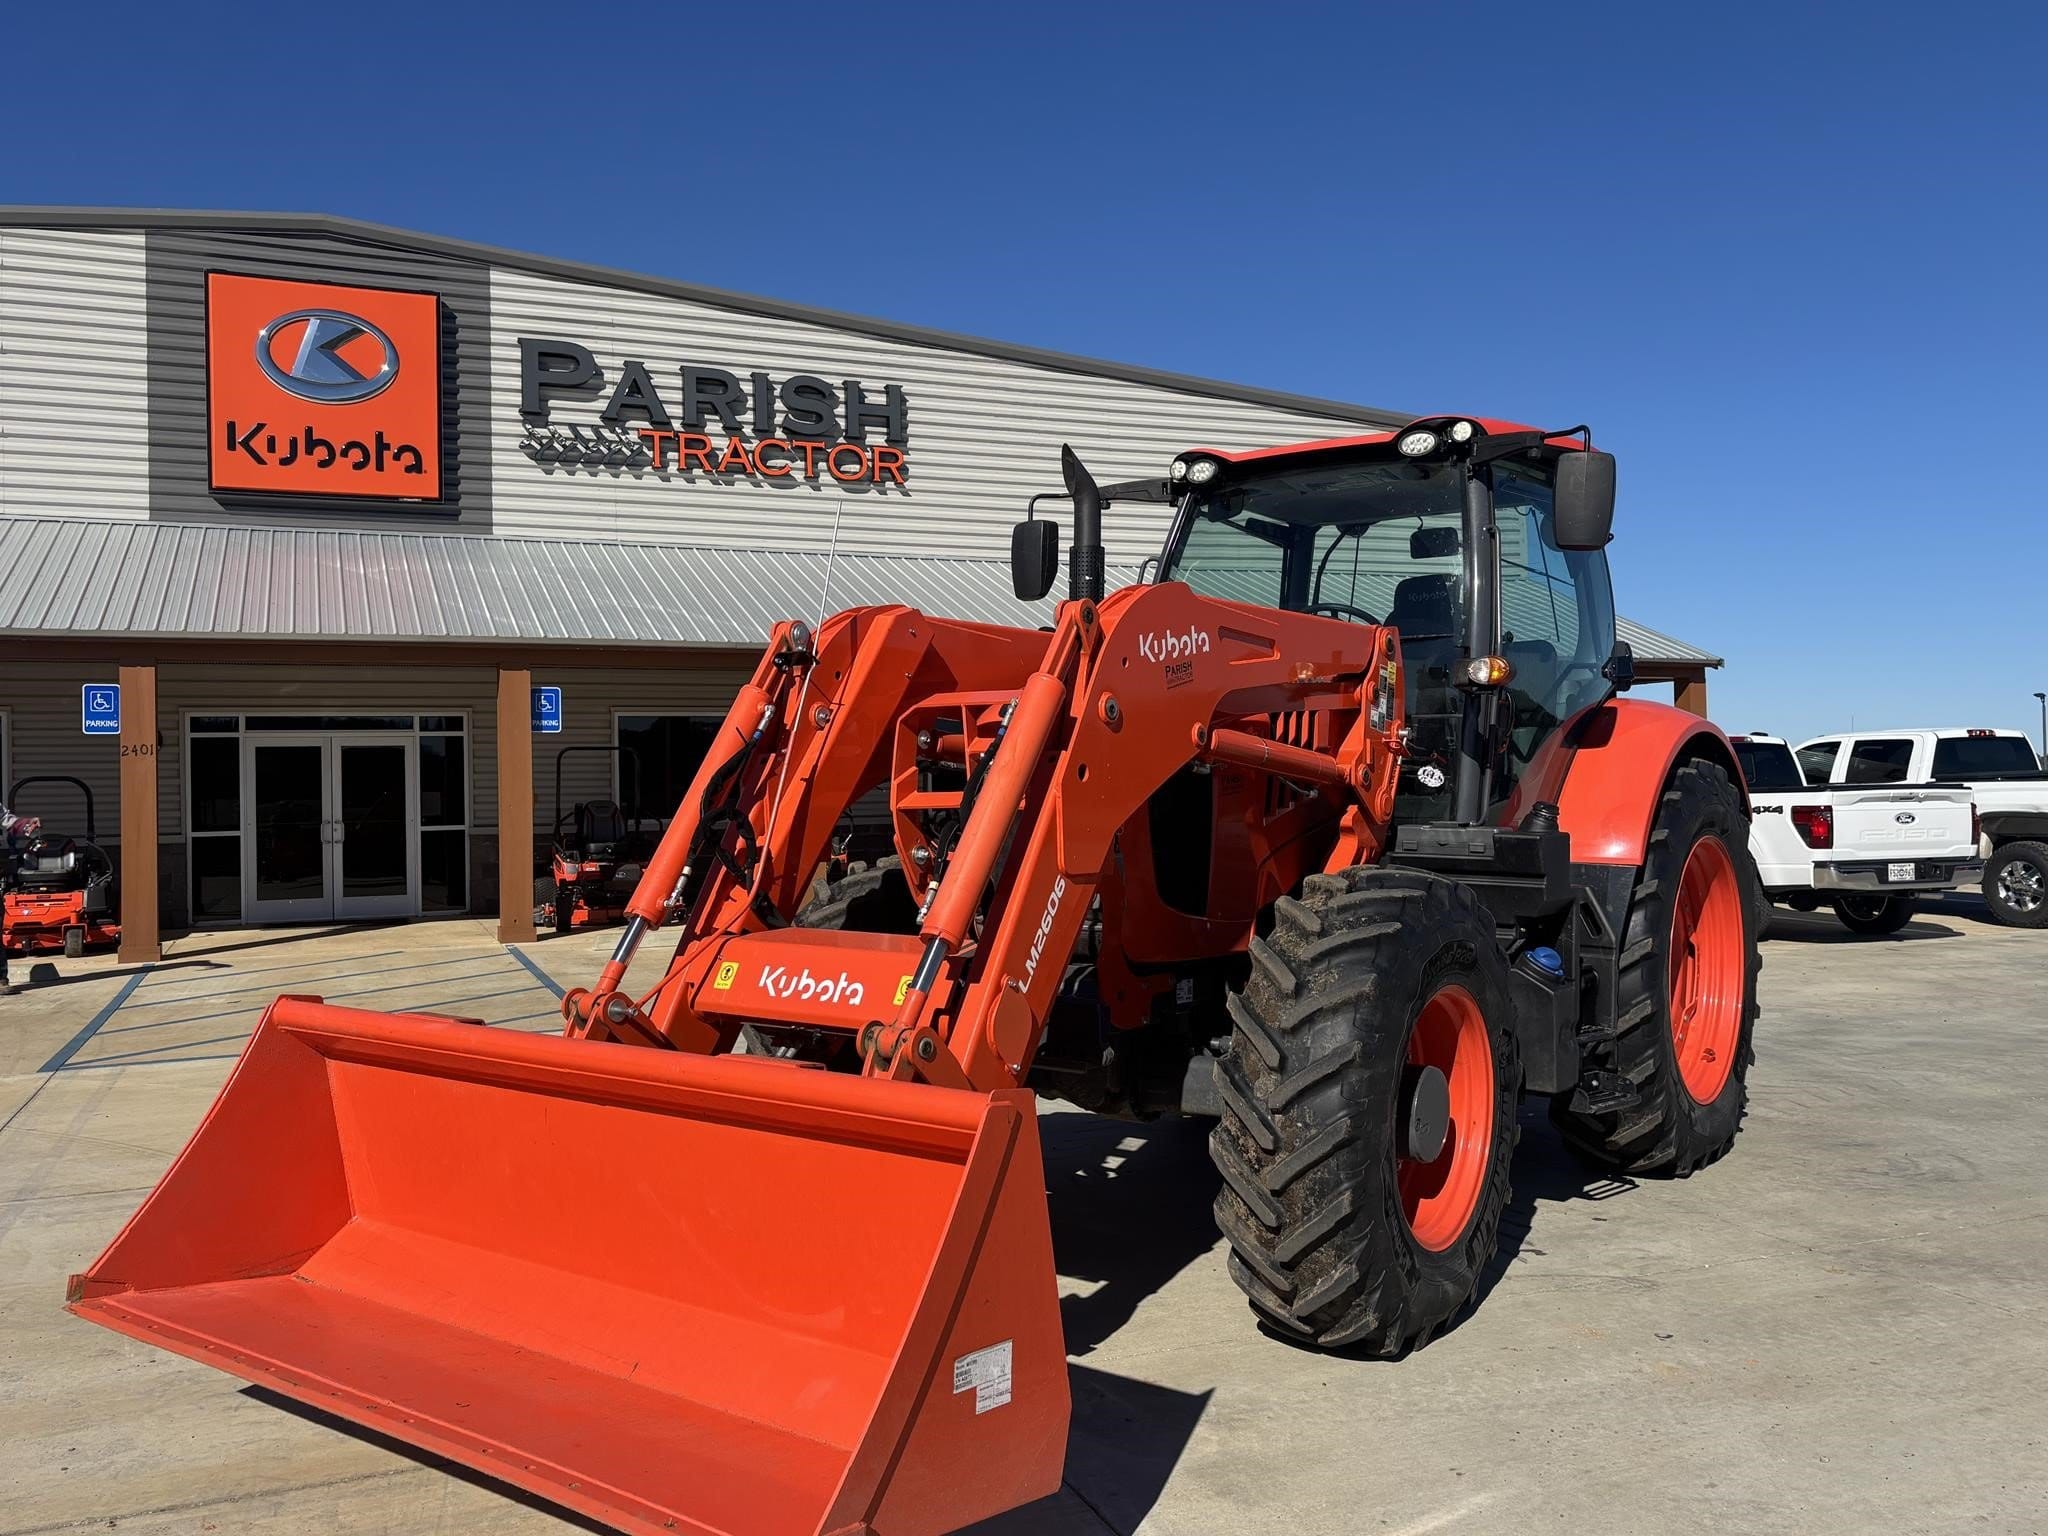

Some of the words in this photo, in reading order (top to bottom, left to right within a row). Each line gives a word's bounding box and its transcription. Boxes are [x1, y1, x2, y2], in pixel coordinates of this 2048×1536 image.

[518, 337, 904, 442] PARISH
[226, 419, 424, 475] Kubota
[638, 428, 906, 484] TRACTOR
[1138, 624, 1210, 663] Kubota
[1165, 661, 1193, 678] PARISH
[85, 719, 119, 728] PARKING
[532, 719, 559, 727] PARKING
[121, 743, 154, 757] 2401
[1017, 874, 1067, 994] LM2606
[758, 965, 865, 1006] Kubota
